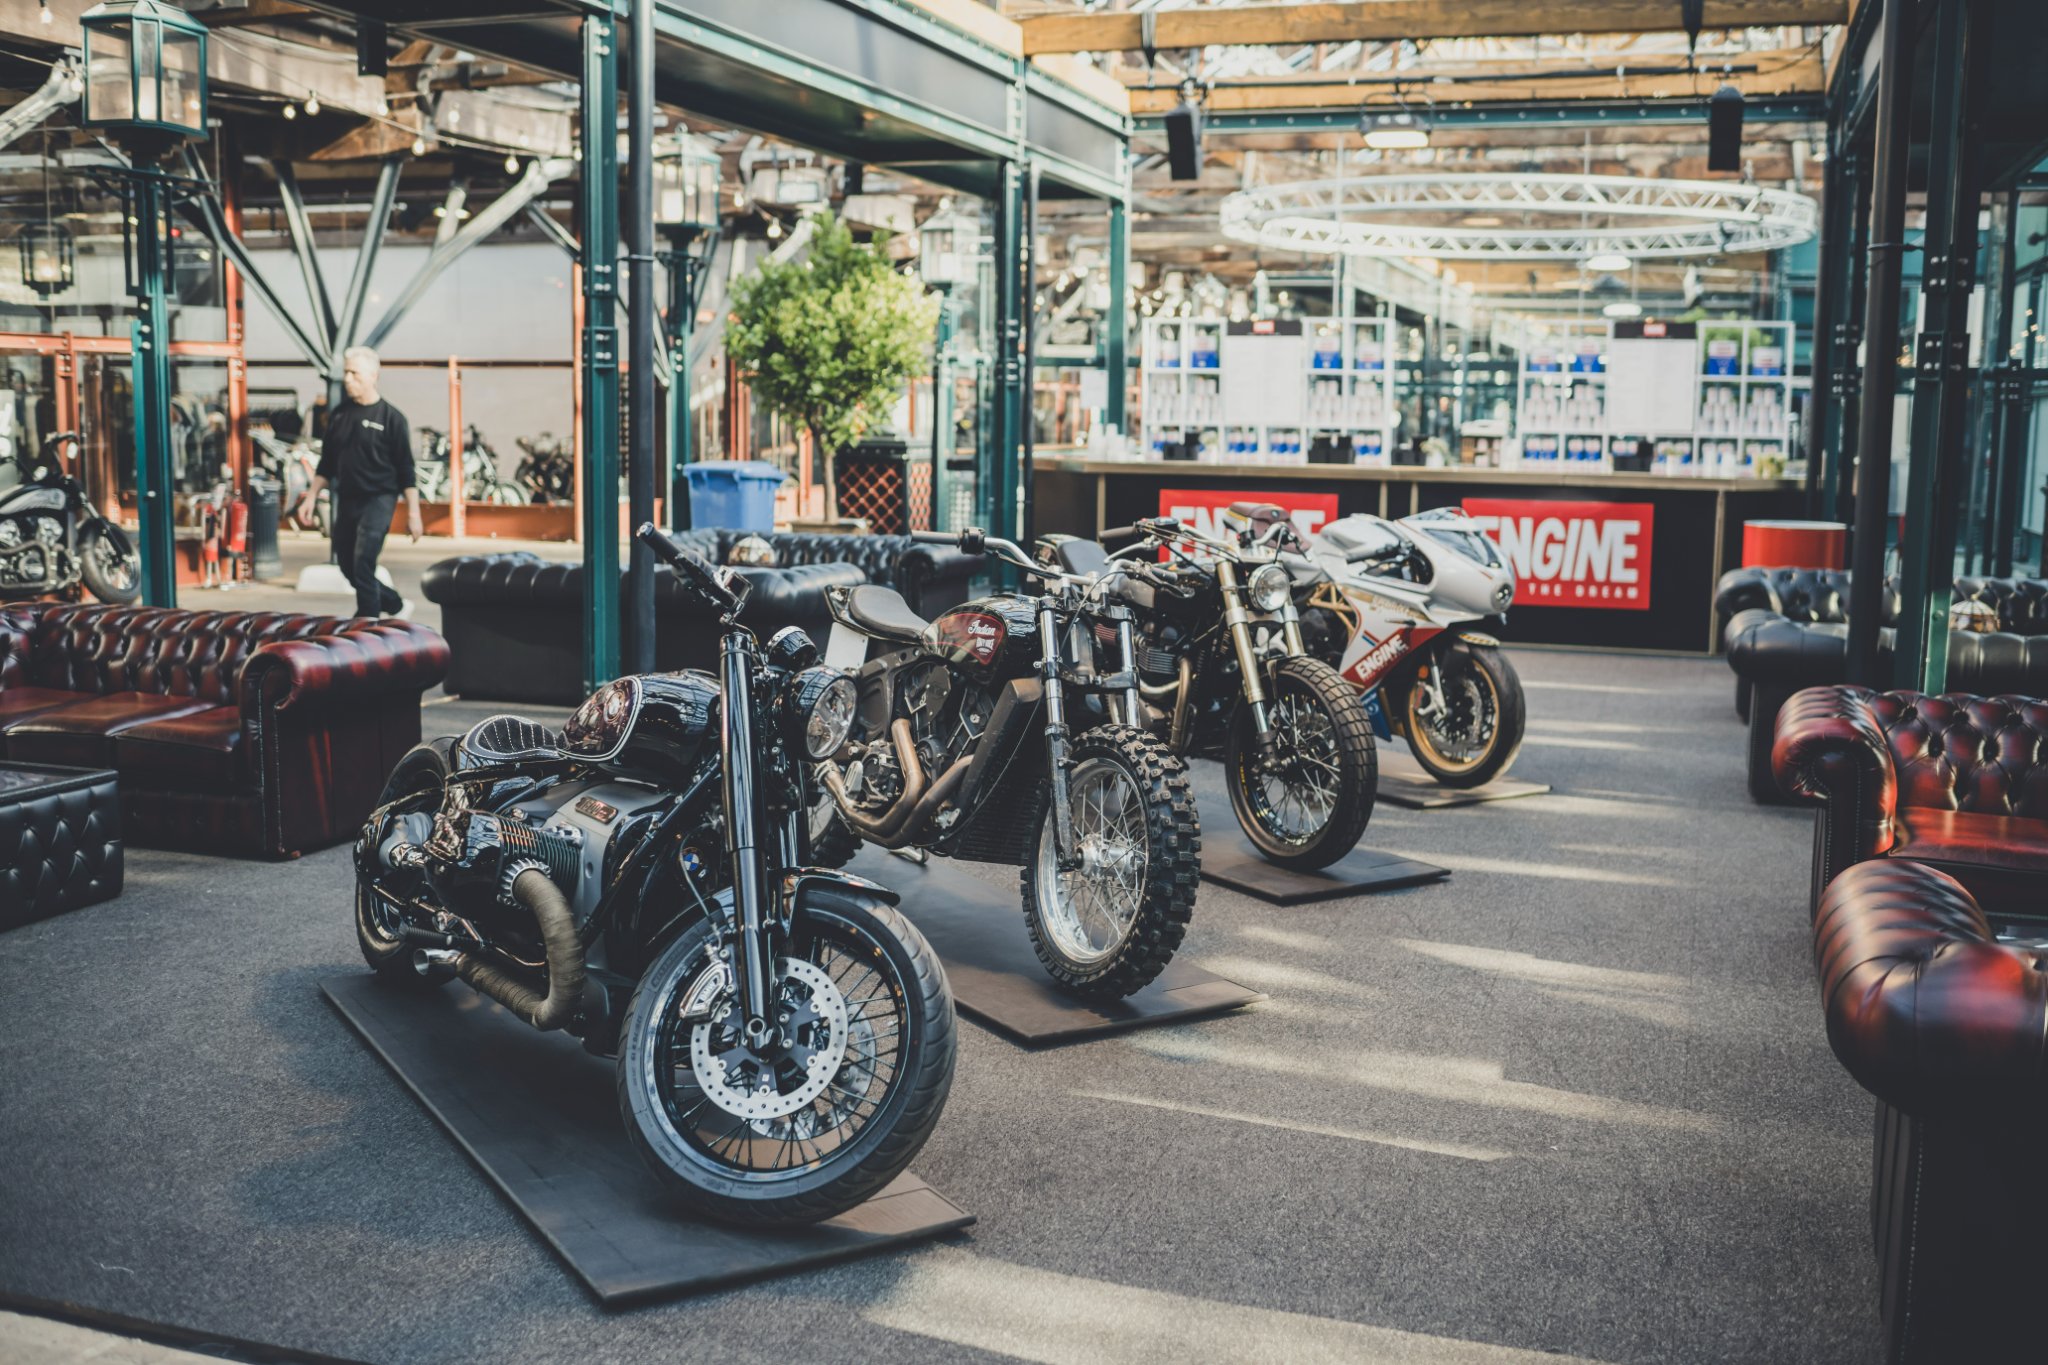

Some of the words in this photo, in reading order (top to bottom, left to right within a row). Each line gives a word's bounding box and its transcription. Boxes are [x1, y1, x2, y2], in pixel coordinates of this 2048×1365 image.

[1528, 583, 1562, 596] THE
[1575, 585, 1639, 599] DREAM
[968, 619, 996, 635] Indian
[1355, 634, 1405, 679] ENGINE
